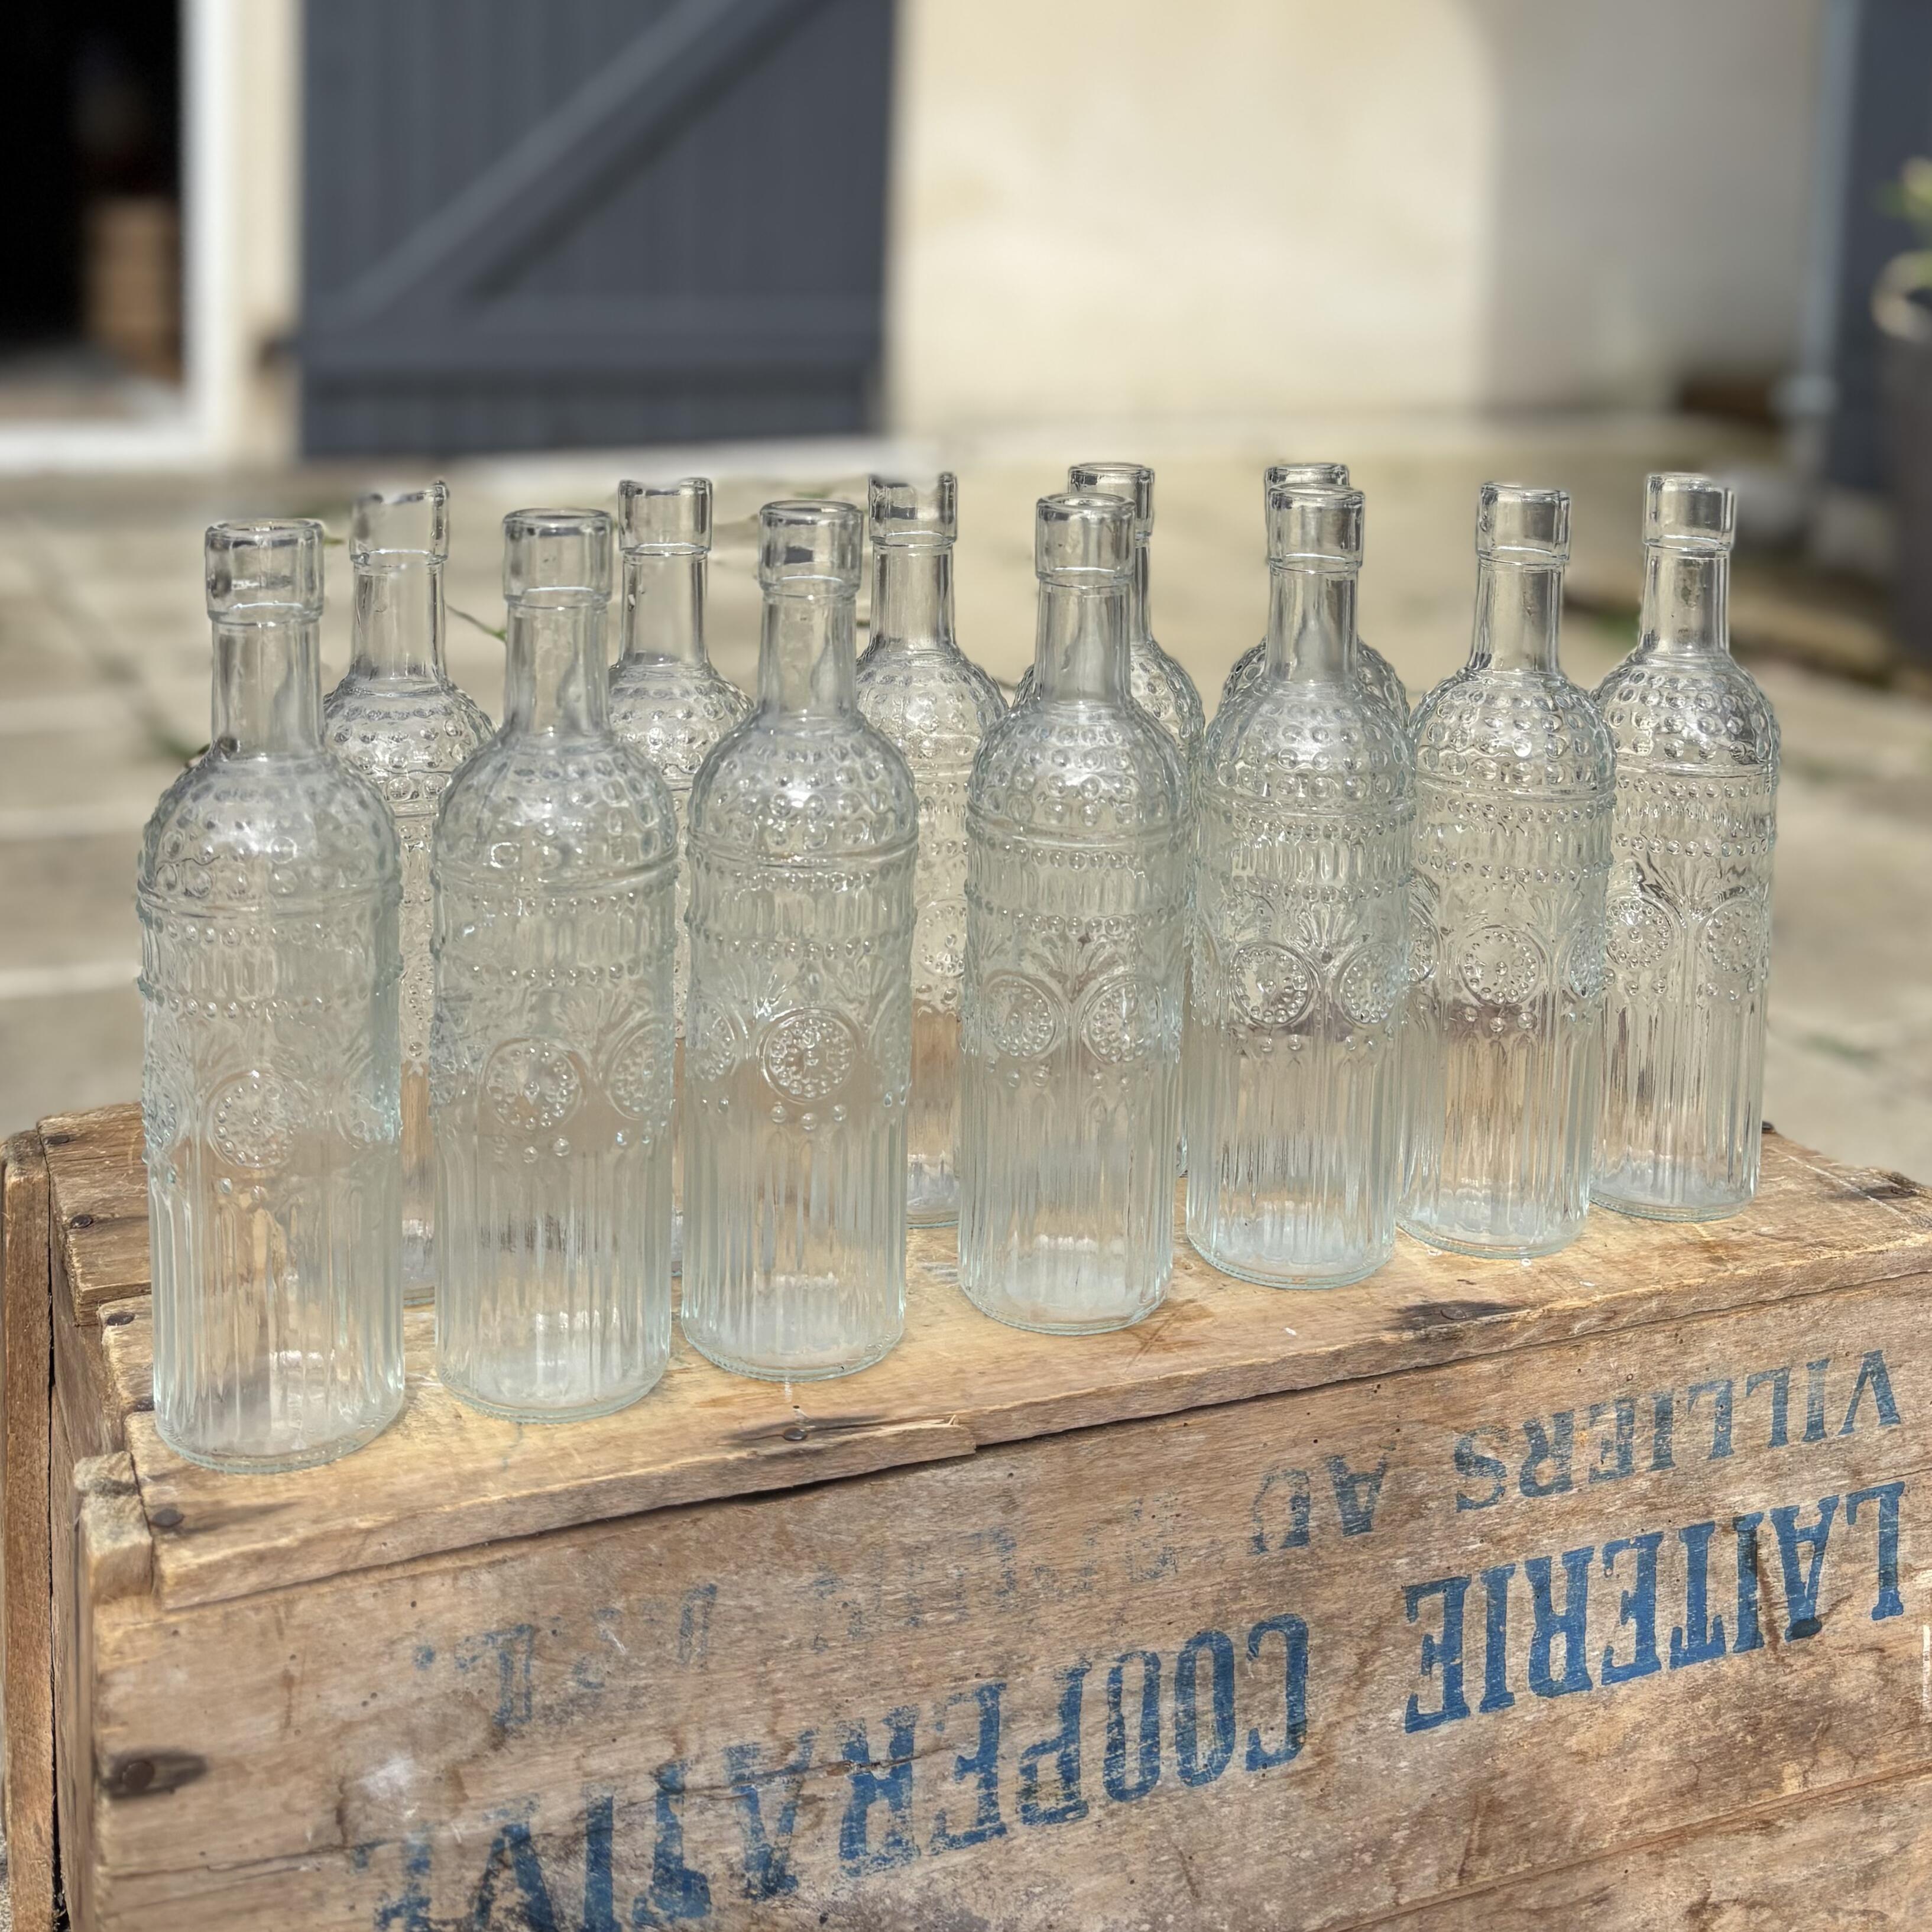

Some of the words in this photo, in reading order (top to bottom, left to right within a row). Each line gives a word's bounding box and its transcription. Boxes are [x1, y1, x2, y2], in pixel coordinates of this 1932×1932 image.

[1247, 1445, 1389, 1554] AU
[1453, 1349, 1901, 1513] VILLIERS
[1403, 1481, 1905, 1734] LAITERIE
